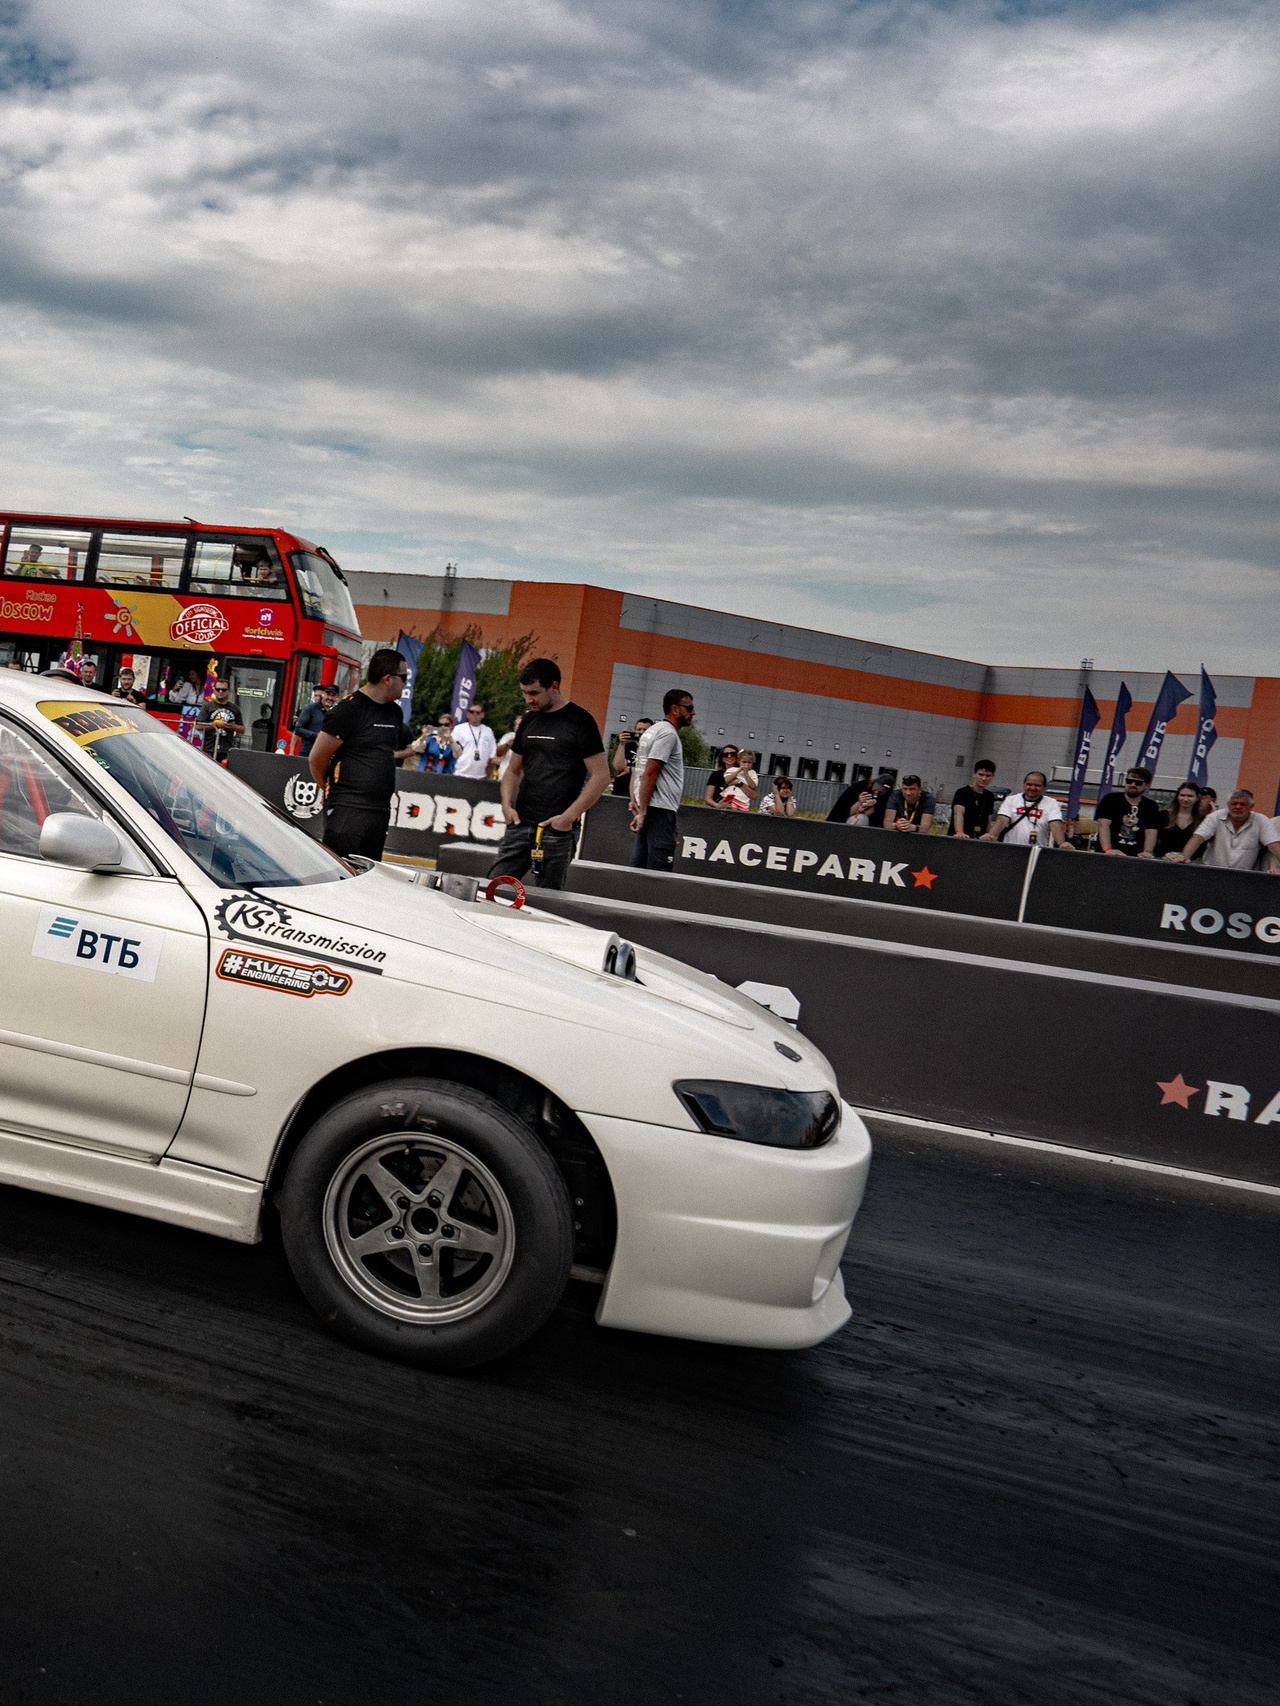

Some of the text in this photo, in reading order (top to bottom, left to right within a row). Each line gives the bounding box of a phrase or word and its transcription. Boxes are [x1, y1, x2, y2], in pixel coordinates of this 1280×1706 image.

[175, 618, 227, 636] OFFICIAL
[194, 631, 216, 641] TOUR
[1146, 720, 1167, 759] ВТБ
[389, 791, 508, 841] DRC
[681, 835, 910, 888] RACEPARK
[1160, 903, 1280, 944] ROSG
[76, 929, 142, 969] ВТБ
[240, 967, 311, 991] ENGINEERING
